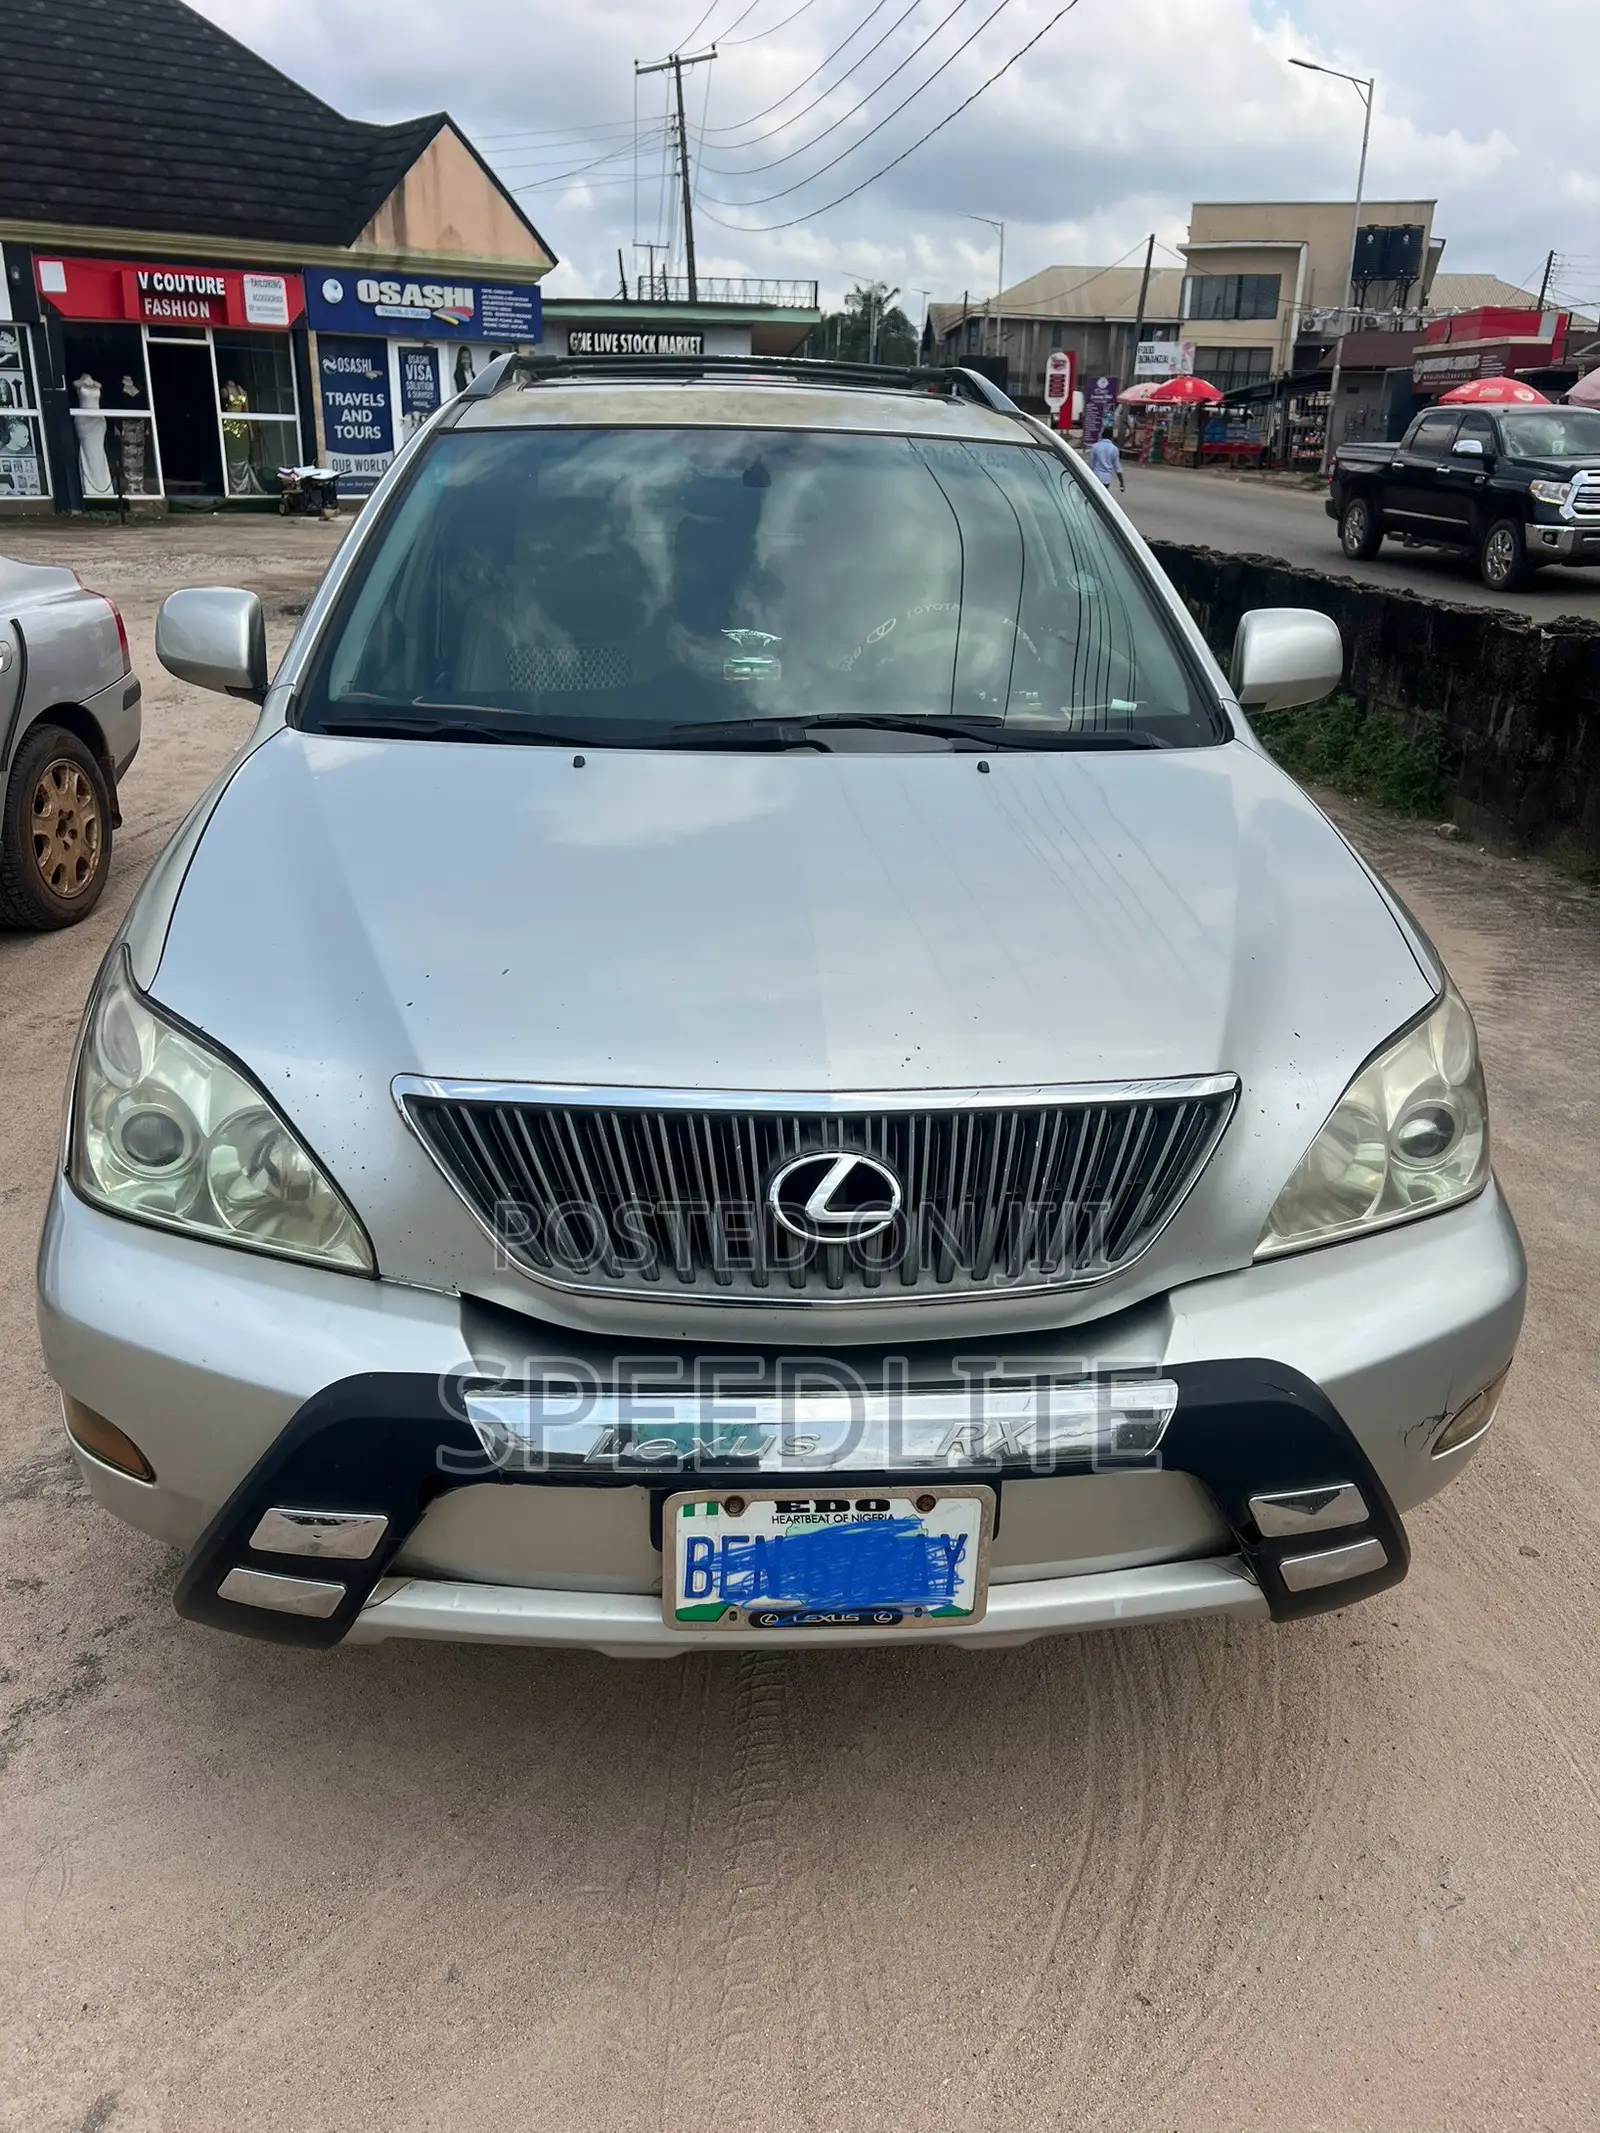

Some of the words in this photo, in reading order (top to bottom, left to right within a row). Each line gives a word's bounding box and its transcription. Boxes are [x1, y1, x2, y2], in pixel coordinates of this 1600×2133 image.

[137, 271, 149, 290] V
[153, 272, 226, 296] COUTURE
[356, 279, 474, 309] OSASHI
[144, 298, 210, 319] FASHION
[594, 333, 618, 353] LIVE
[620, 334, 657, 354] STOCK
[658, 335, 702, 355] MARKET
[337, 357, 373, 374] OSASHI
[405, 364, 433, 381] VISA
[325, 392, 386, 407] TRAVELS
[341, 409, 373, 423] AND
[333, 425, 382, 439] TOURS
[332, 459, 352, 473] OUR
[354, 459, 388, 473] WORLD
[934, 1419, 1037, 1459] RX
[774, 1499, 891, 1514] EDO
[771, 1514, 830, 1525] HEARTBEAT
[833, 1513, 849, 1524] OF
[851, 1512, 895, 1523] NIGERIA
[793, 1612, 860, 1624] LEXUS
